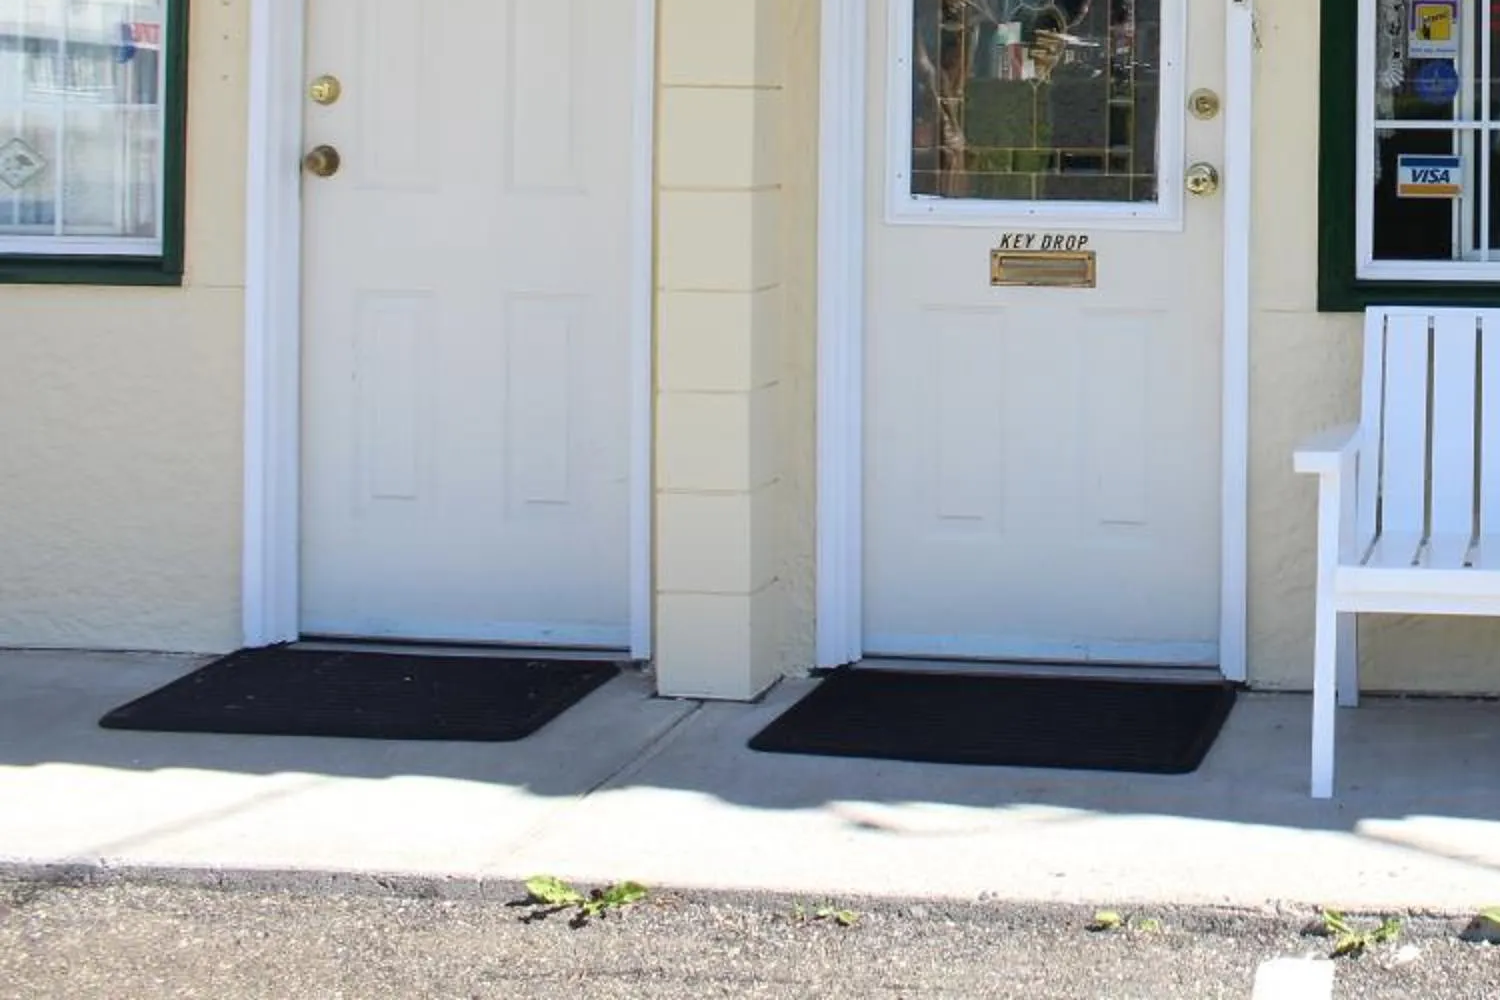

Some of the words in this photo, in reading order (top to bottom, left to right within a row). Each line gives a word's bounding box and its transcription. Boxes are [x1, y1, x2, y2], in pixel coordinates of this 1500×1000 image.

[1411, 168, 1451, 184] VISA
[1000, 233, 1035, 249] KEY
[1041, 234, 1089, 250] DROP
